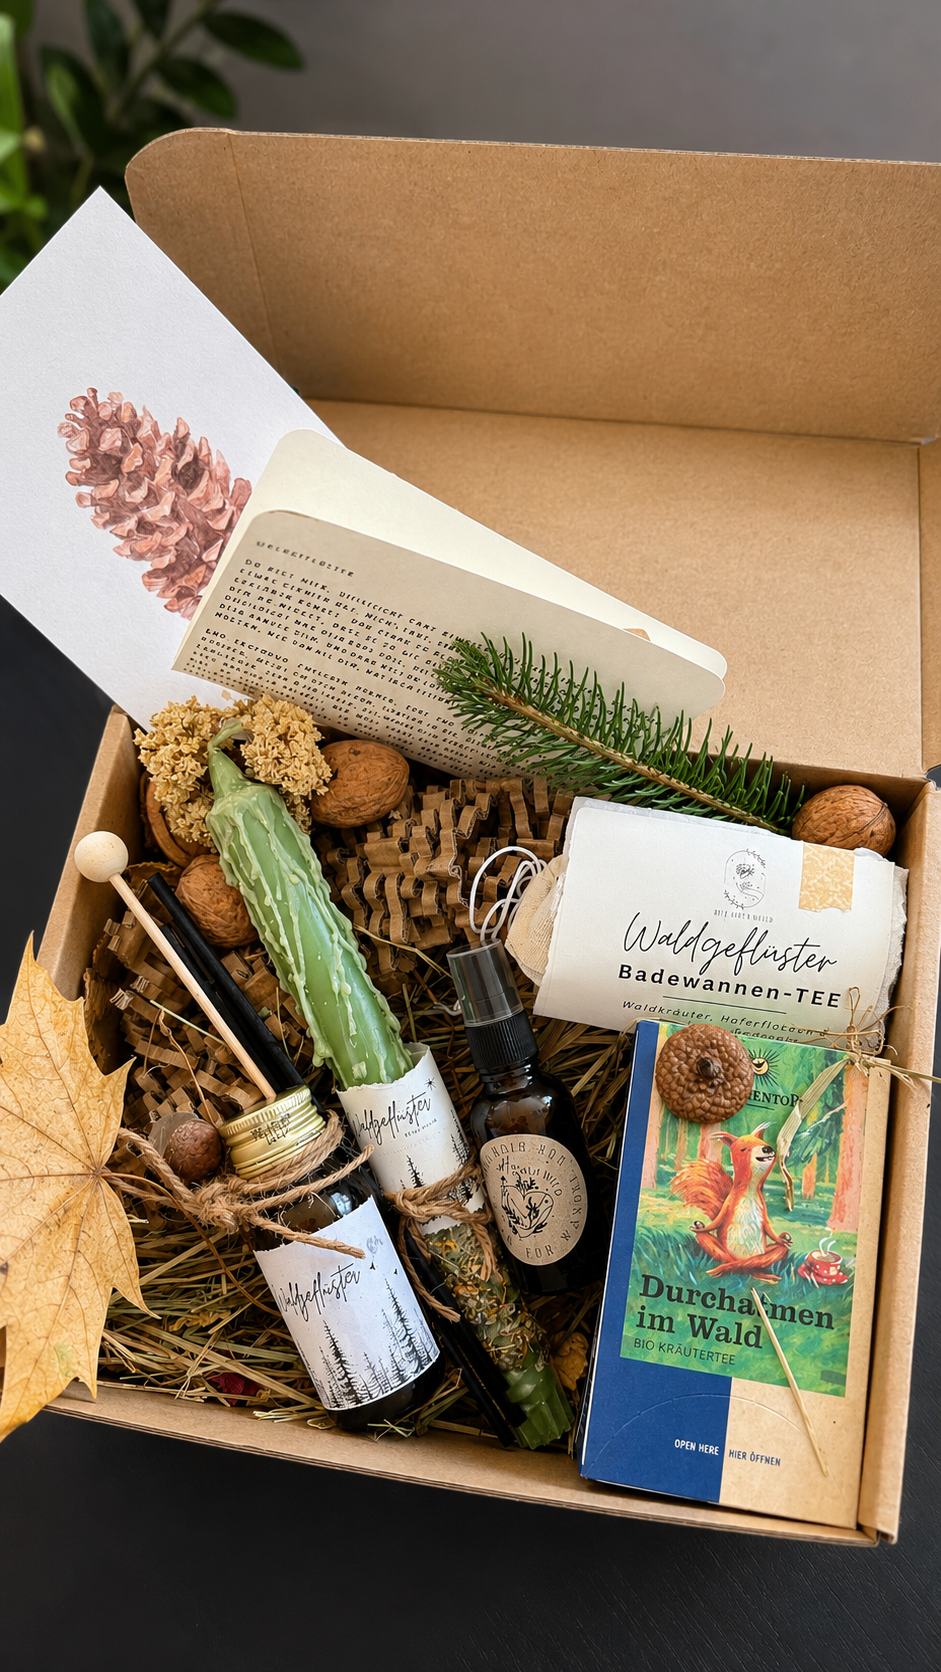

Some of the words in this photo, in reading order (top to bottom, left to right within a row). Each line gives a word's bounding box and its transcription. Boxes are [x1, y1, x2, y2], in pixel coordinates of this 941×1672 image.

[623, 911, 838, 976] Waldgeflüster
[618, 963, 842, 1009] Badewannen-TEE
[635, 1305, 676, 1334] im
[687, 1313, 763, 1349] Wald
[633, 1337, 655, 1351] BIO
[658, 1342, 736, 1366] KRÄUTERTEE
[674, 1439, 696, 1451] OPEN
[698, 1443, 719, 1456] HERE
[728, 1449, 748, 1461] HIER
[749, 1451, 782, 1467] ÖFFNEN
